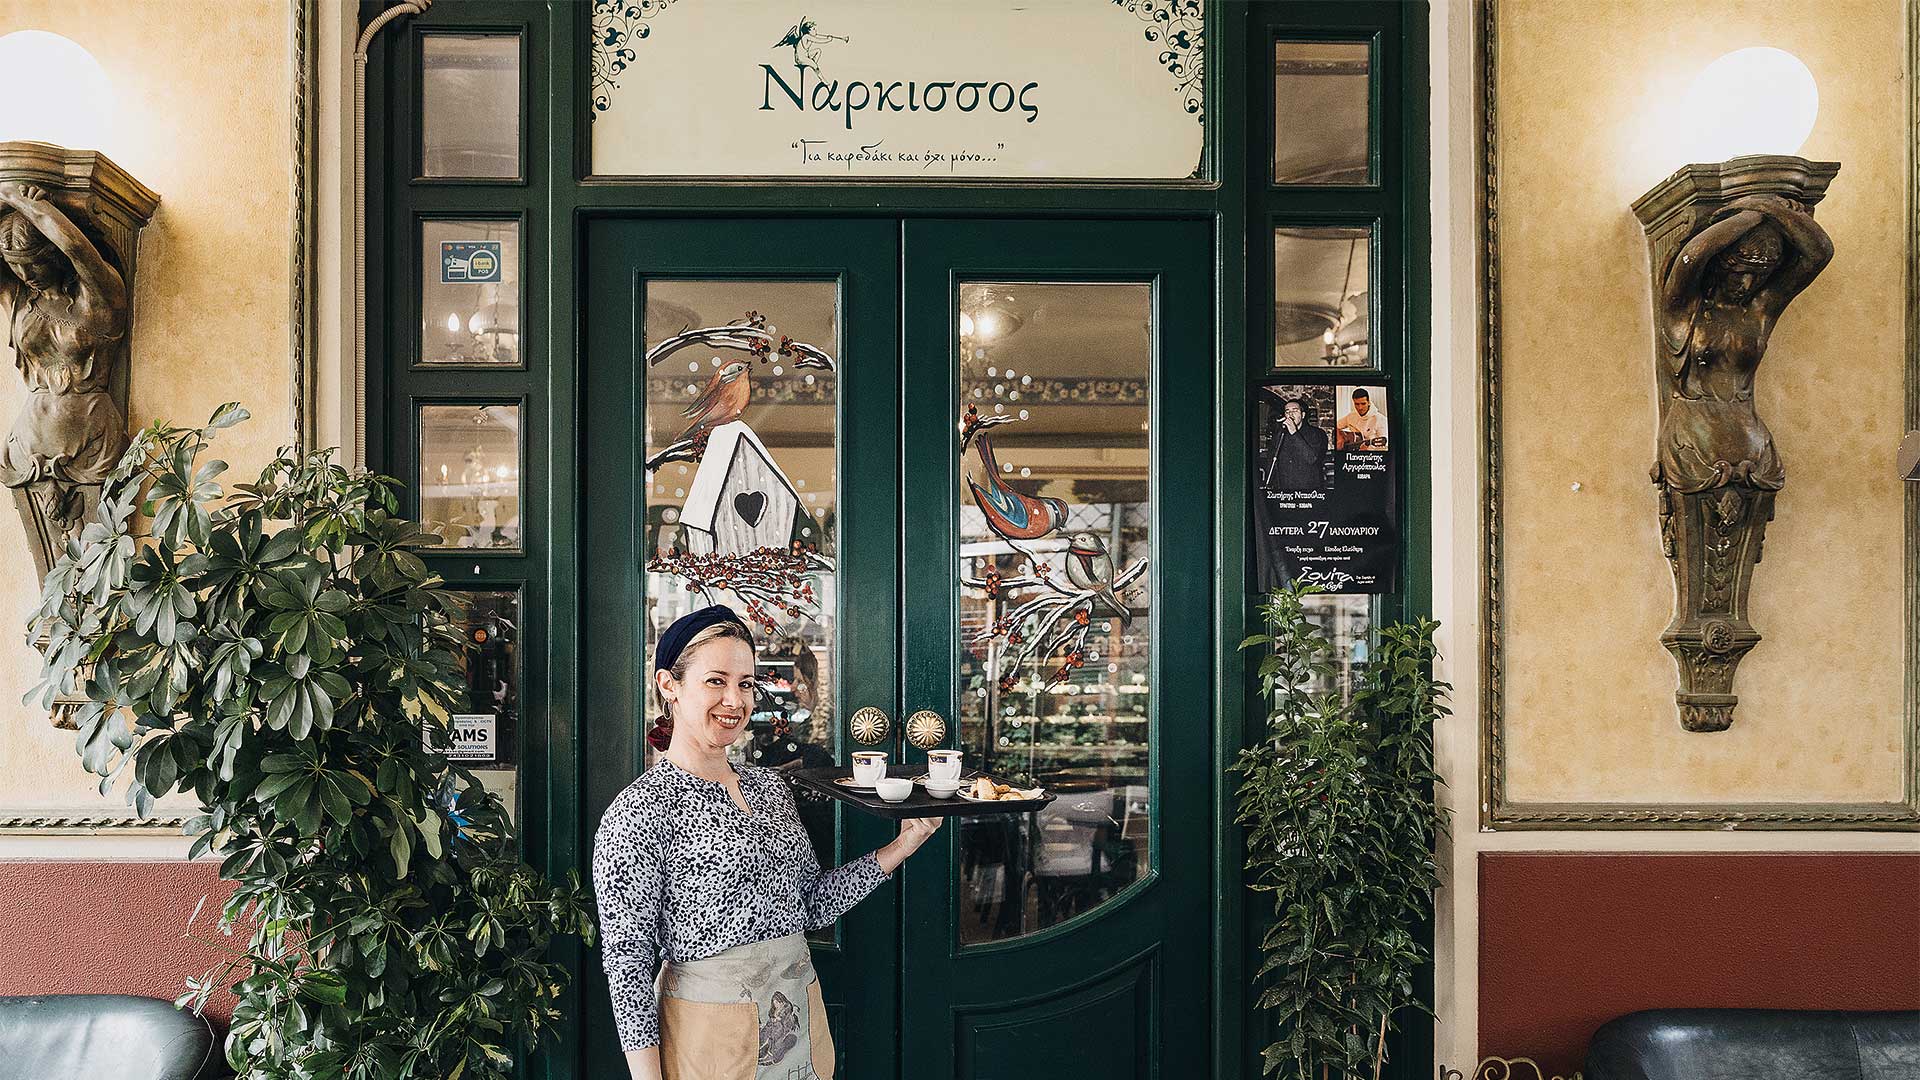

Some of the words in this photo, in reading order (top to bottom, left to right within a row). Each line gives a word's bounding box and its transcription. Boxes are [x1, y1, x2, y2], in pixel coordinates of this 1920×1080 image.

[758, 63, 1039, 130] Ναρκισσος
[827, 138, 893, 172] καφεδάκι
[898, 152, 919, 162] και
[923, 150, 946, 169] όχι
[1269, 527, 1304, 535] ΔΕΥΤΕΡΑ
[1308, 521, 1329, 538] 27
[1329, 527, 1379, 536] ΙΑΝΟΥΑΡΙΟΥ
